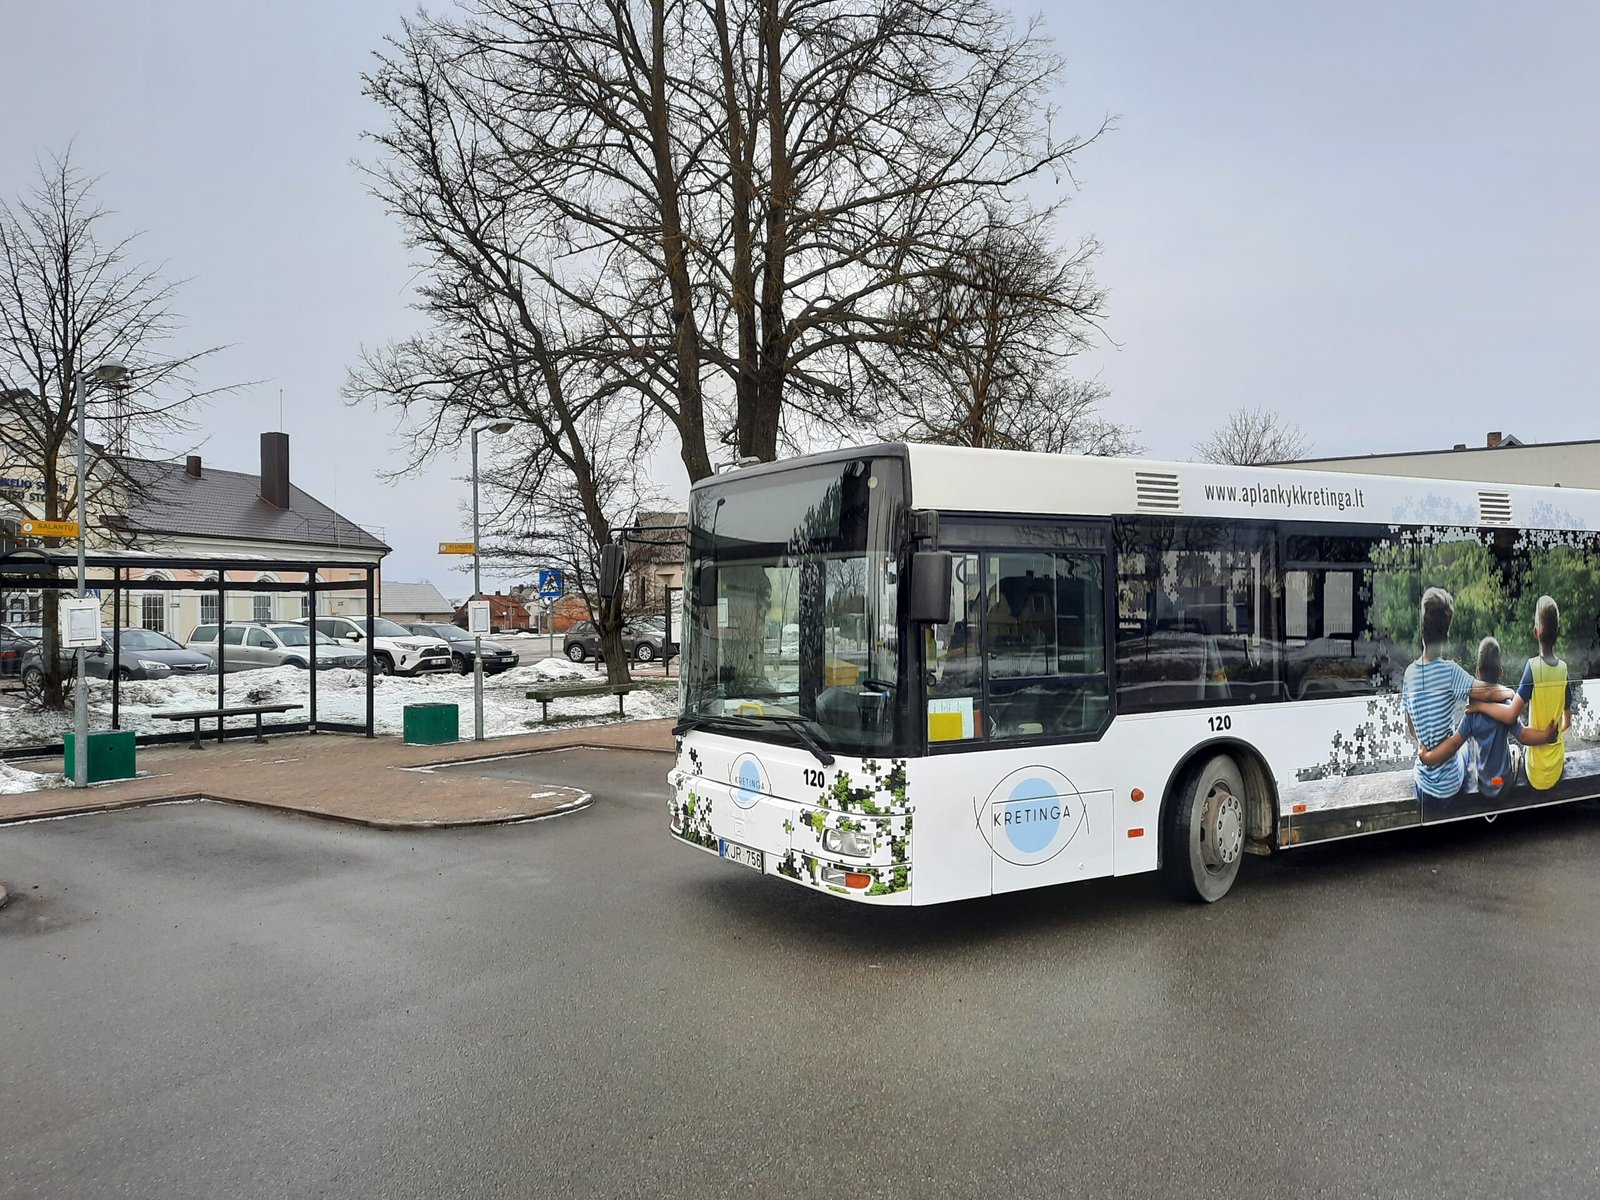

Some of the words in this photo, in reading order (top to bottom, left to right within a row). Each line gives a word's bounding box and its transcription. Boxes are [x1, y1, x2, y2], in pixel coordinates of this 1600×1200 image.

[1204, 482, 1365, 511] www.aplankykkretinga.lt
[1207, 714, 1232, 732] 120
[734, 776, 765, 790] KRETINGA
[803, 768, 825, 788] 120
[993, 804, 1071, 827] KRETINGA
[724, 843, 742, 861] KJR
[746, 850, 761, 868] 756
